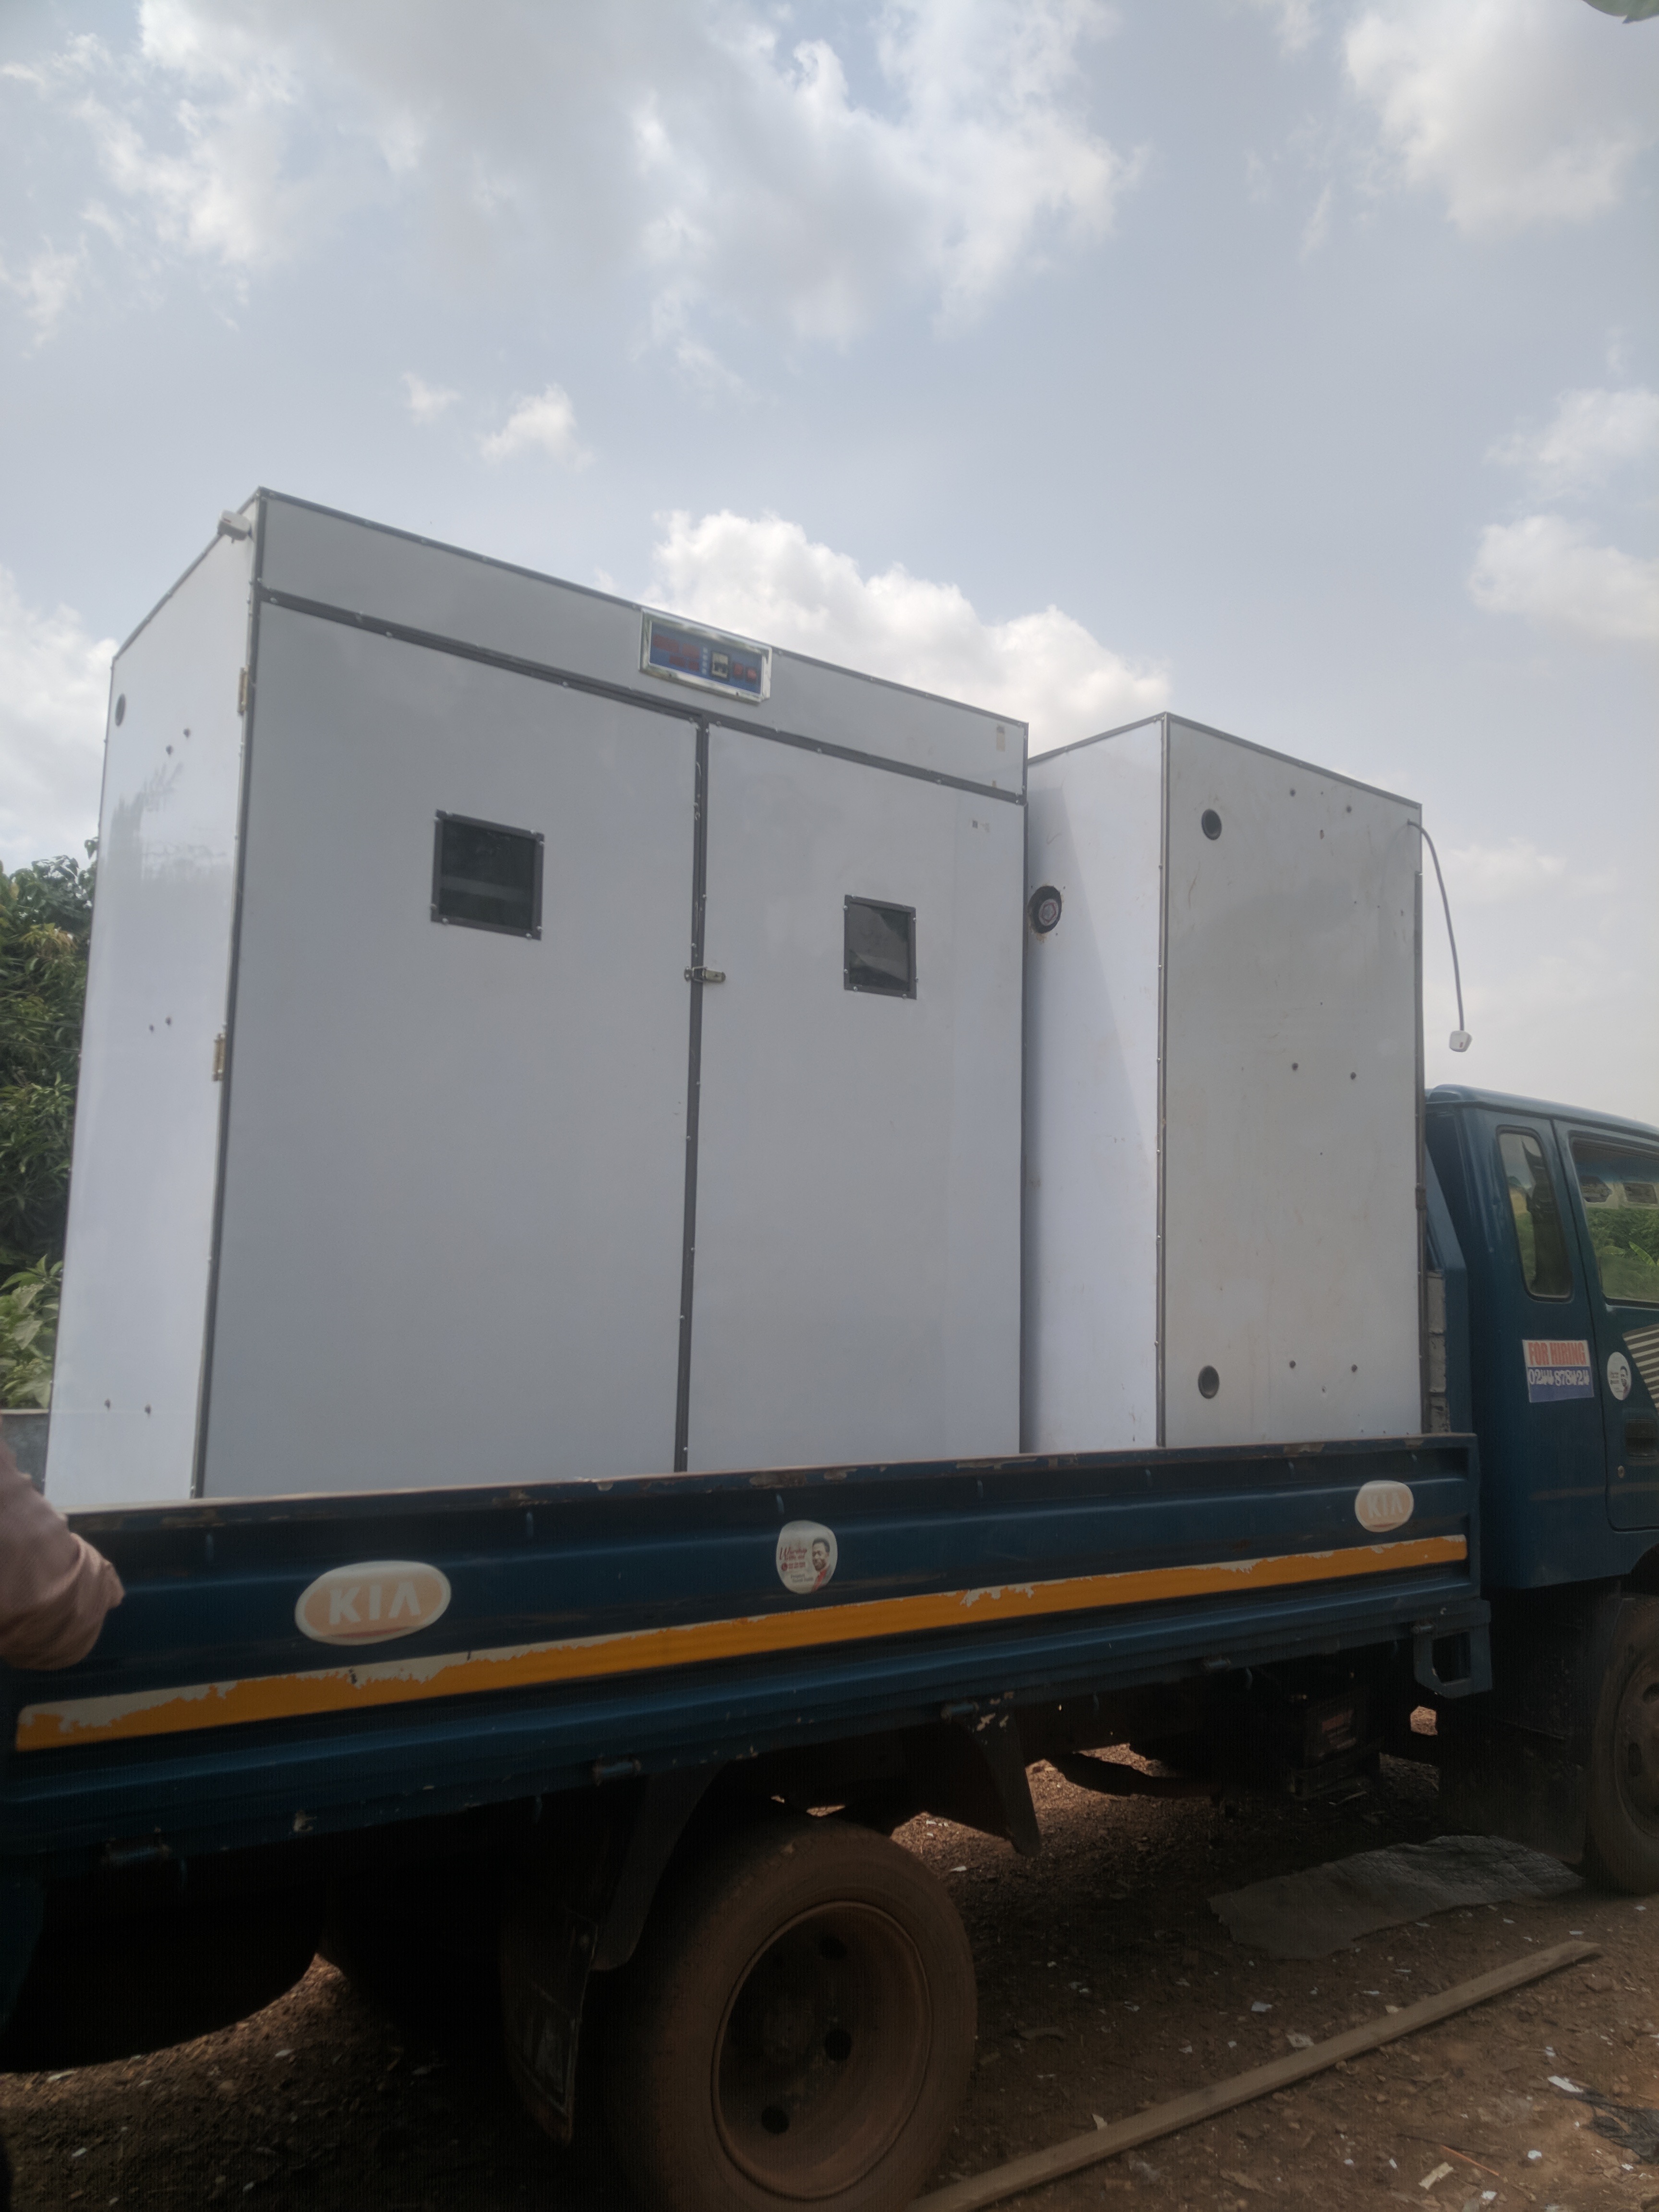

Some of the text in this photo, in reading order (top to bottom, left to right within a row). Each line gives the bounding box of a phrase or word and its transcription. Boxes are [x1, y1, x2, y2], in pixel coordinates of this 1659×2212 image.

[1528, 1342, 1587, 1366] FOR HIRING
[1366, 1491, 1404, 1519] KIA
[328, 1581, 421, 1626] KIA
